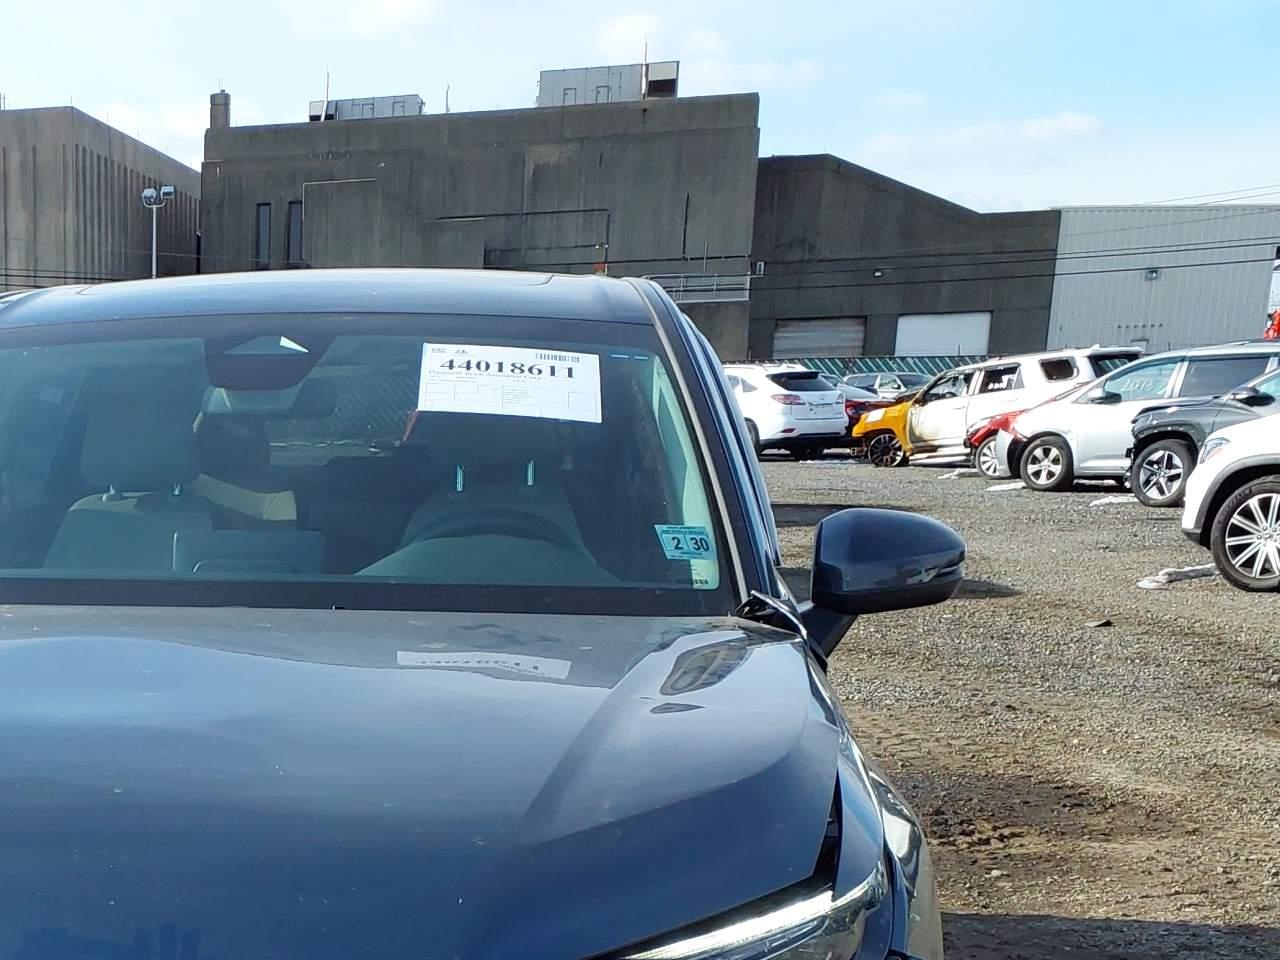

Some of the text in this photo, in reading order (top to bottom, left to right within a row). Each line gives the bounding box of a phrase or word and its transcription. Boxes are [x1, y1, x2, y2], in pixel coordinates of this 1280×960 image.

[439, 359, 574, 378] 44018611
[672, 536, 710, 552] 2 30
